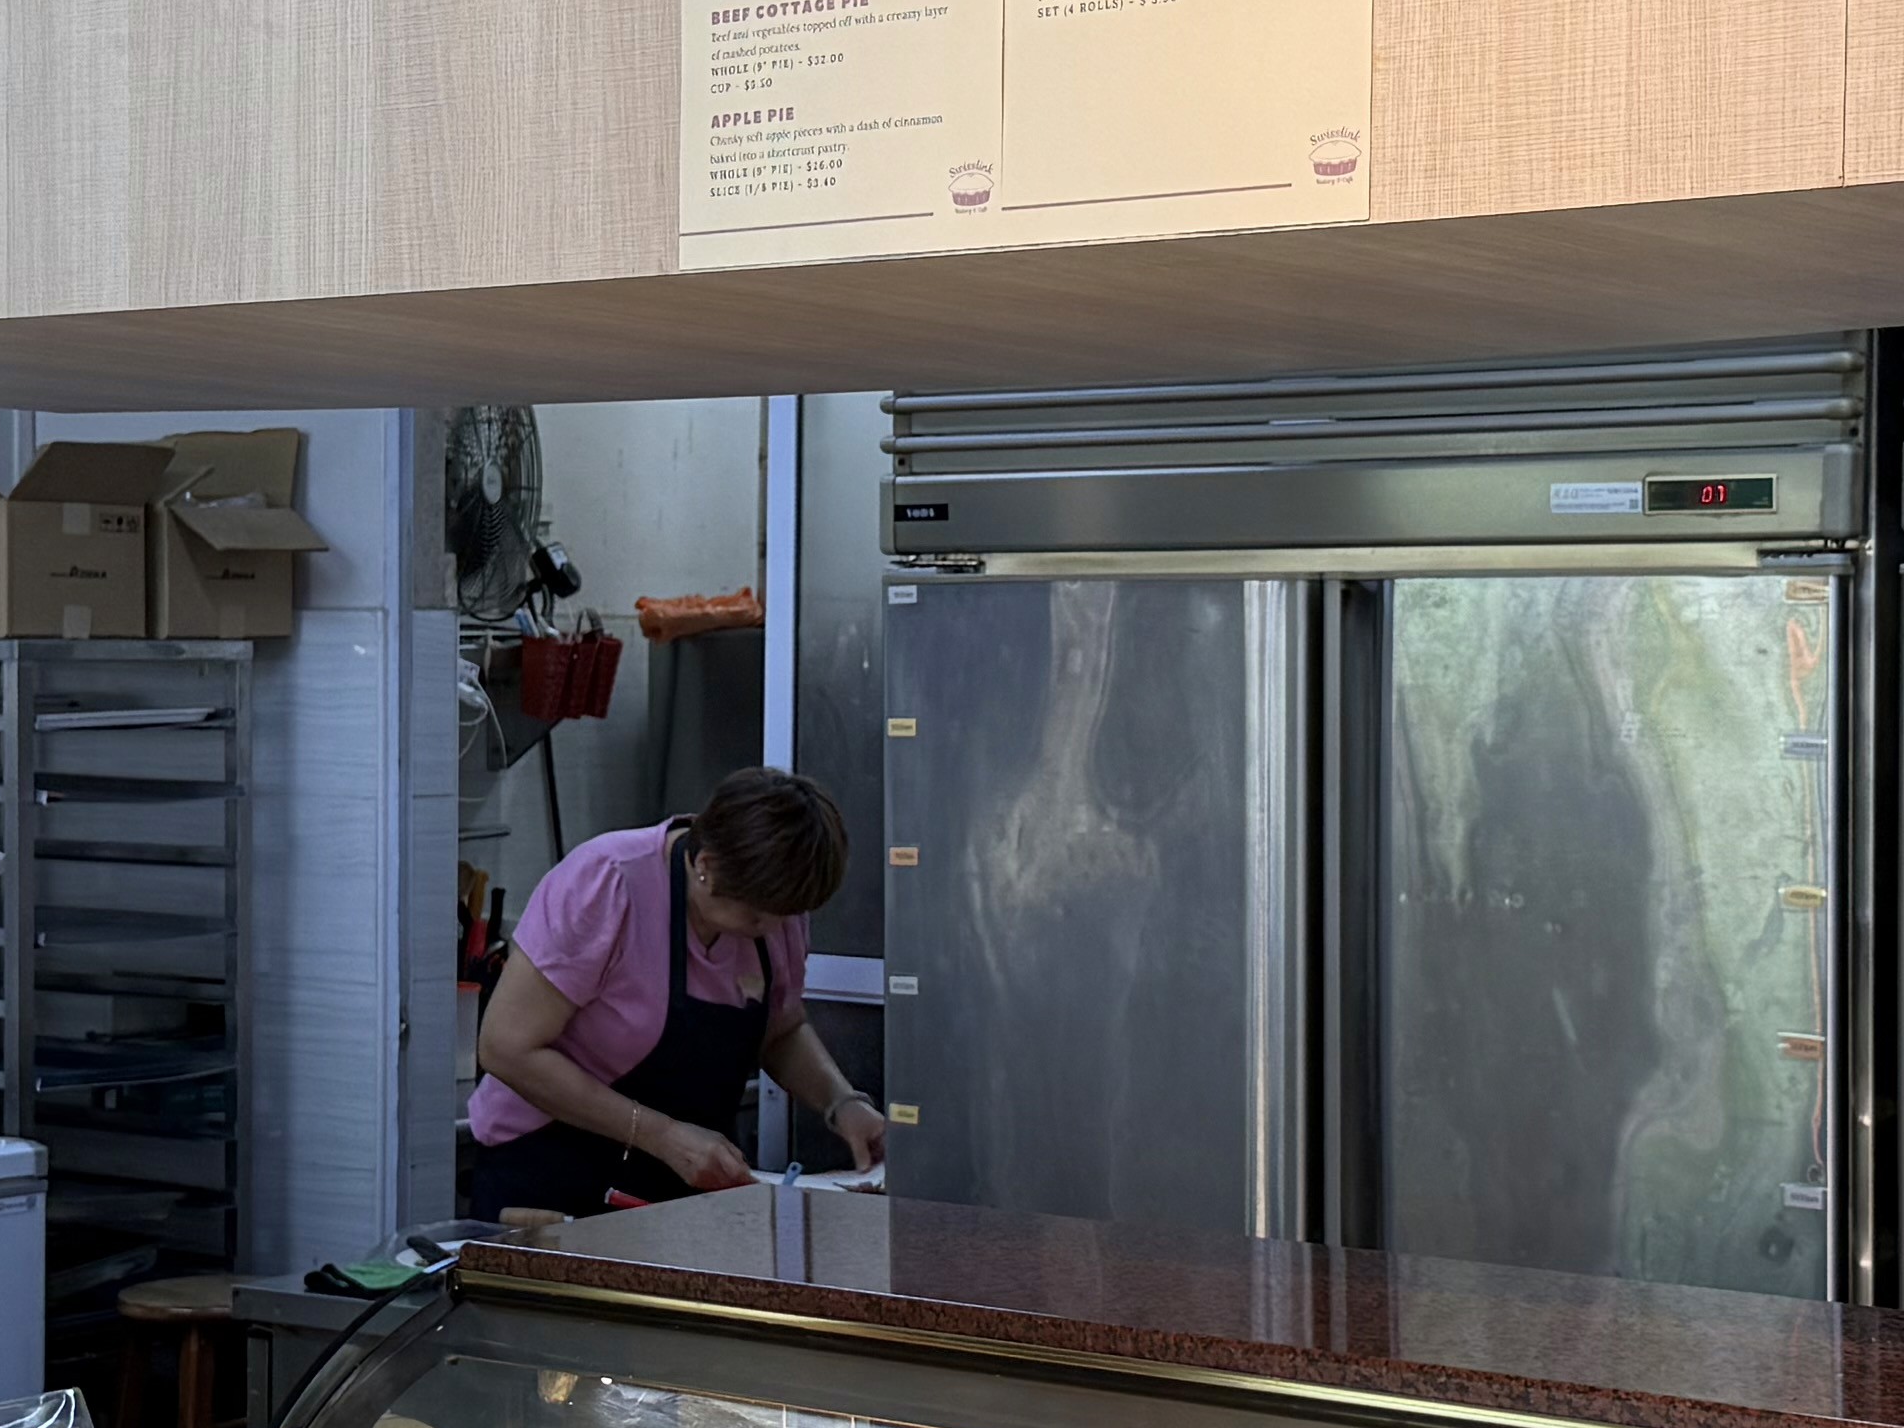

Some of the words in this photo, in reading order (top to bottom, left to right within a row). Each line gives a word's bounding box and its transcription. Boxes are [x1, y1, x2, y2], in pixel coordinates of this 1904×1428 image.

[711, 7, 750, 25] BEEF
[803, 18, 836, 34] topped
[924, 5, 948, 17] layer
[1038, 6, 1060, 18] SET
[1064, 4, 1074, 17] (4
[711, 111, 761, 129] APPLE
[768, 107, 794, 122] PIE
[857, 120, 879, 131] dash
[894, 115, 943, 127] cinnamon
